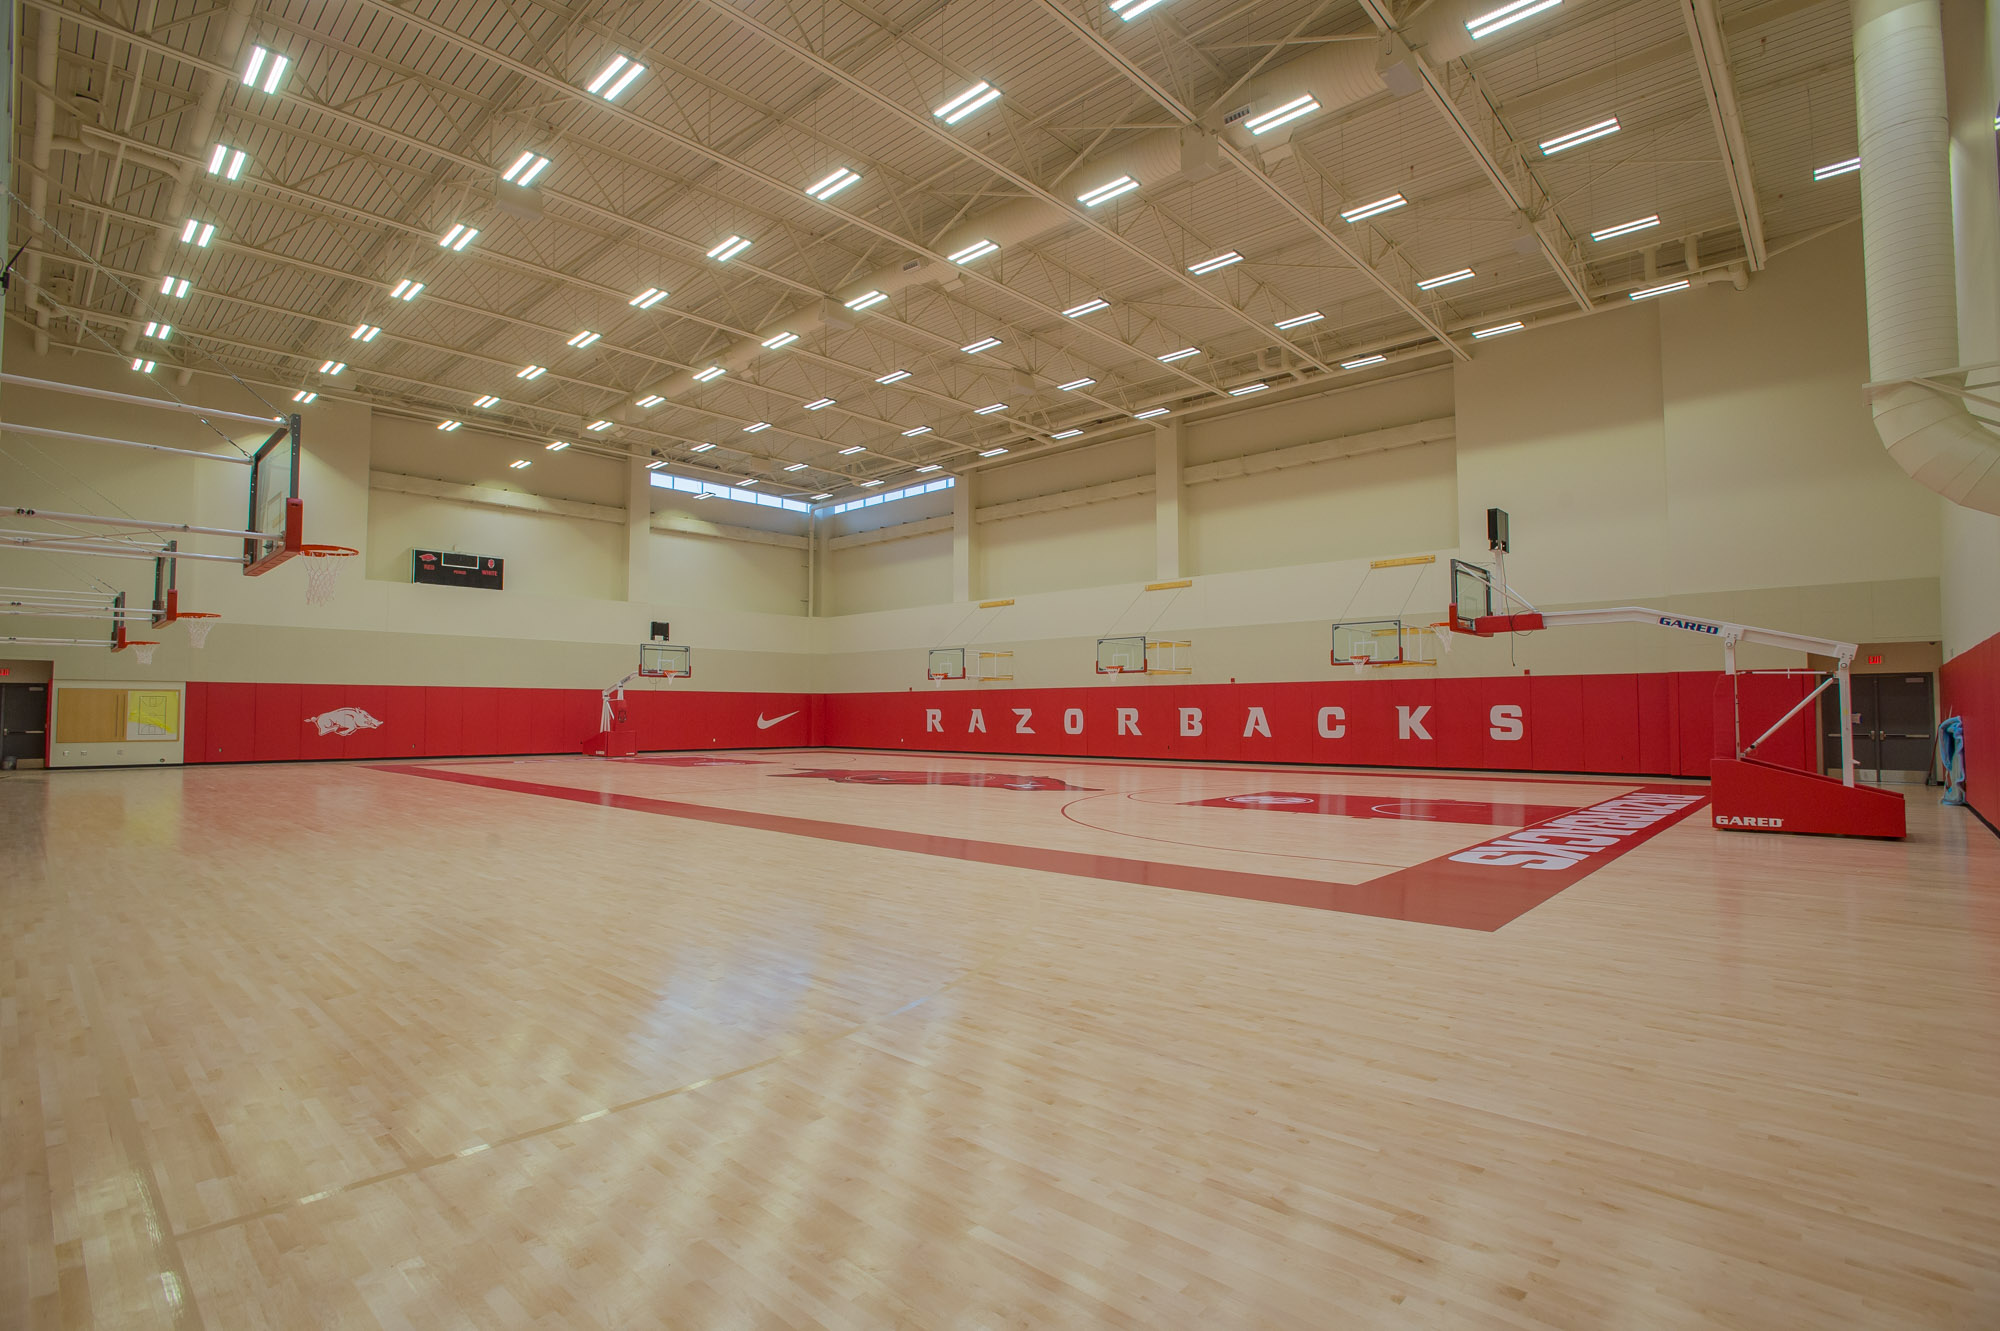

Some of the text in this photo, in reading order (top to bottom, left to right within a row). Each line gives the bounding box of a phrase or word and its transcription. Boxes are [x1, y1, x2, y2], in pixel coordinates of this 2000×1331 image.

[1659, 617, 1719, 635] GARED
[926, 704, 1525, 741] RAZORBACKS
[1448, 793, 1706, 871] RAZORBACKS
[1715, 815, 1783, 828] GARED
